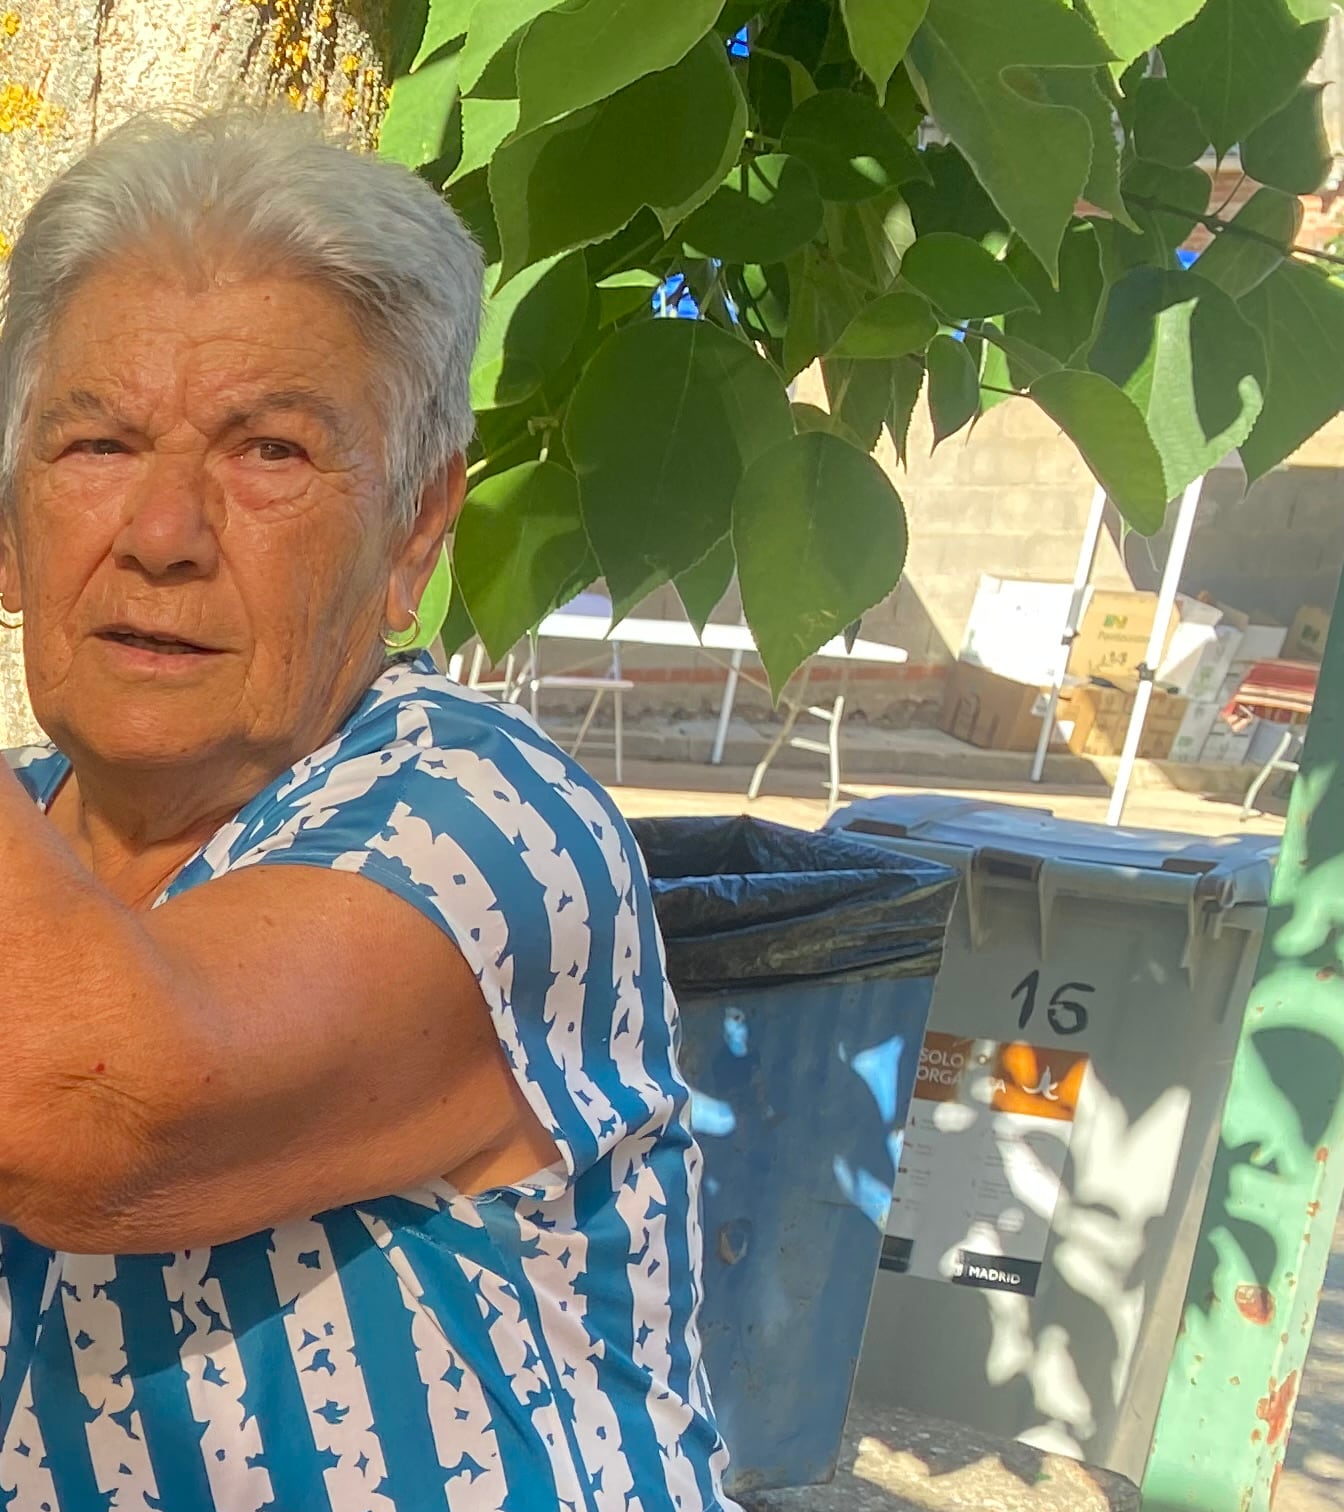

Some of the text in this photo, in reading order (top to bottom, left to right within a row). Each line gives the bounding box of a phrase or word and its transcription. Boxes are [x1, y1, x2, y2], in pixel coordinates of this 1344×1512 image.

[1011, 969, 1096, 1035] 16
[919, 1047, 964, 1068] SOLO
[968, 1265, 1021, 1285] MADRID
